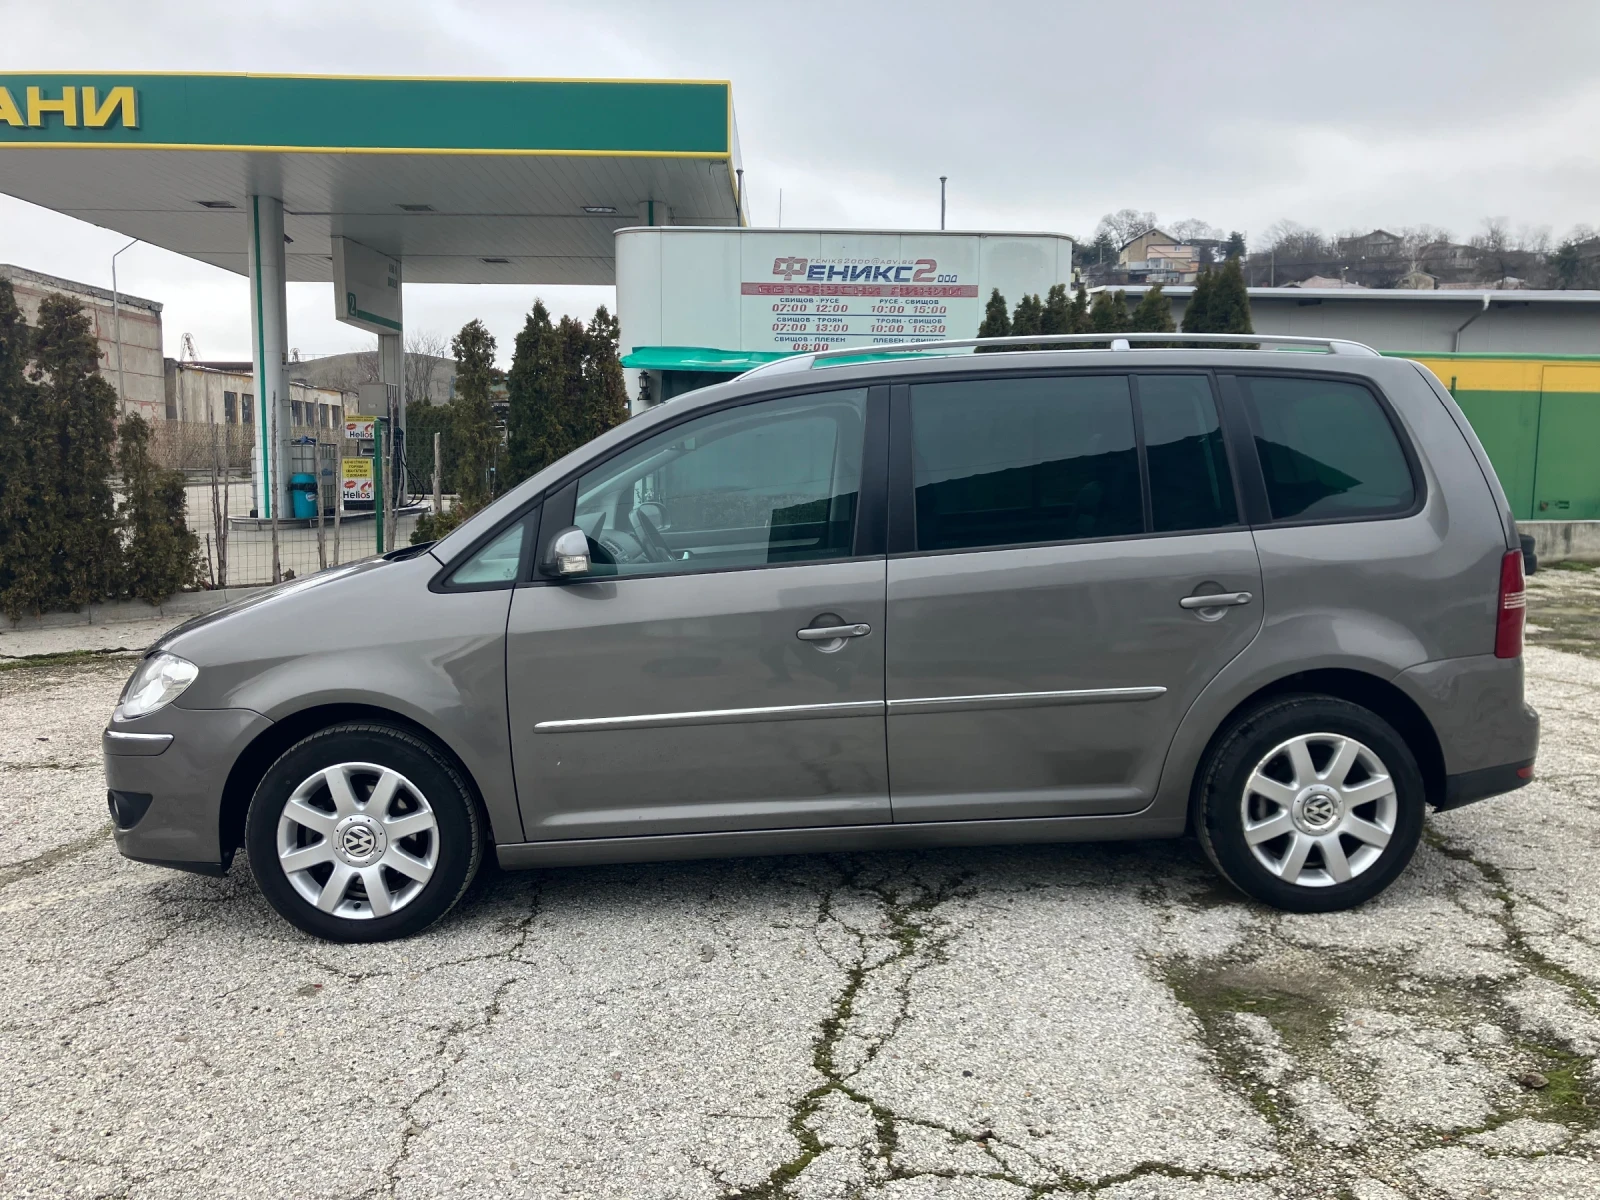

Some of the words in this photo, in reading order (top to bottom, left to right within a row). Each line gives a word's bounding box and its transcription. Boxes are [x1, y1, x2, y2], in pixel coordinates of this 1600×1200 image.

[349, 295, 355, 314] 2
[772, 304, 807, 312] 07:00
[815, 304, 848, 313] 12:00
[871, 305, 904, 313] 10:00
[913, 305, 947, 314] 15:00
[772, 323, 807, 332] 07:00
[815, 324, 849, 332] 13:00
[870, 324, 904, 333] 10:00
[912, 325, 946, 333] 16:30
[349, 430, 373, 438] Helios
[343, 489, 371, 499] Helios
